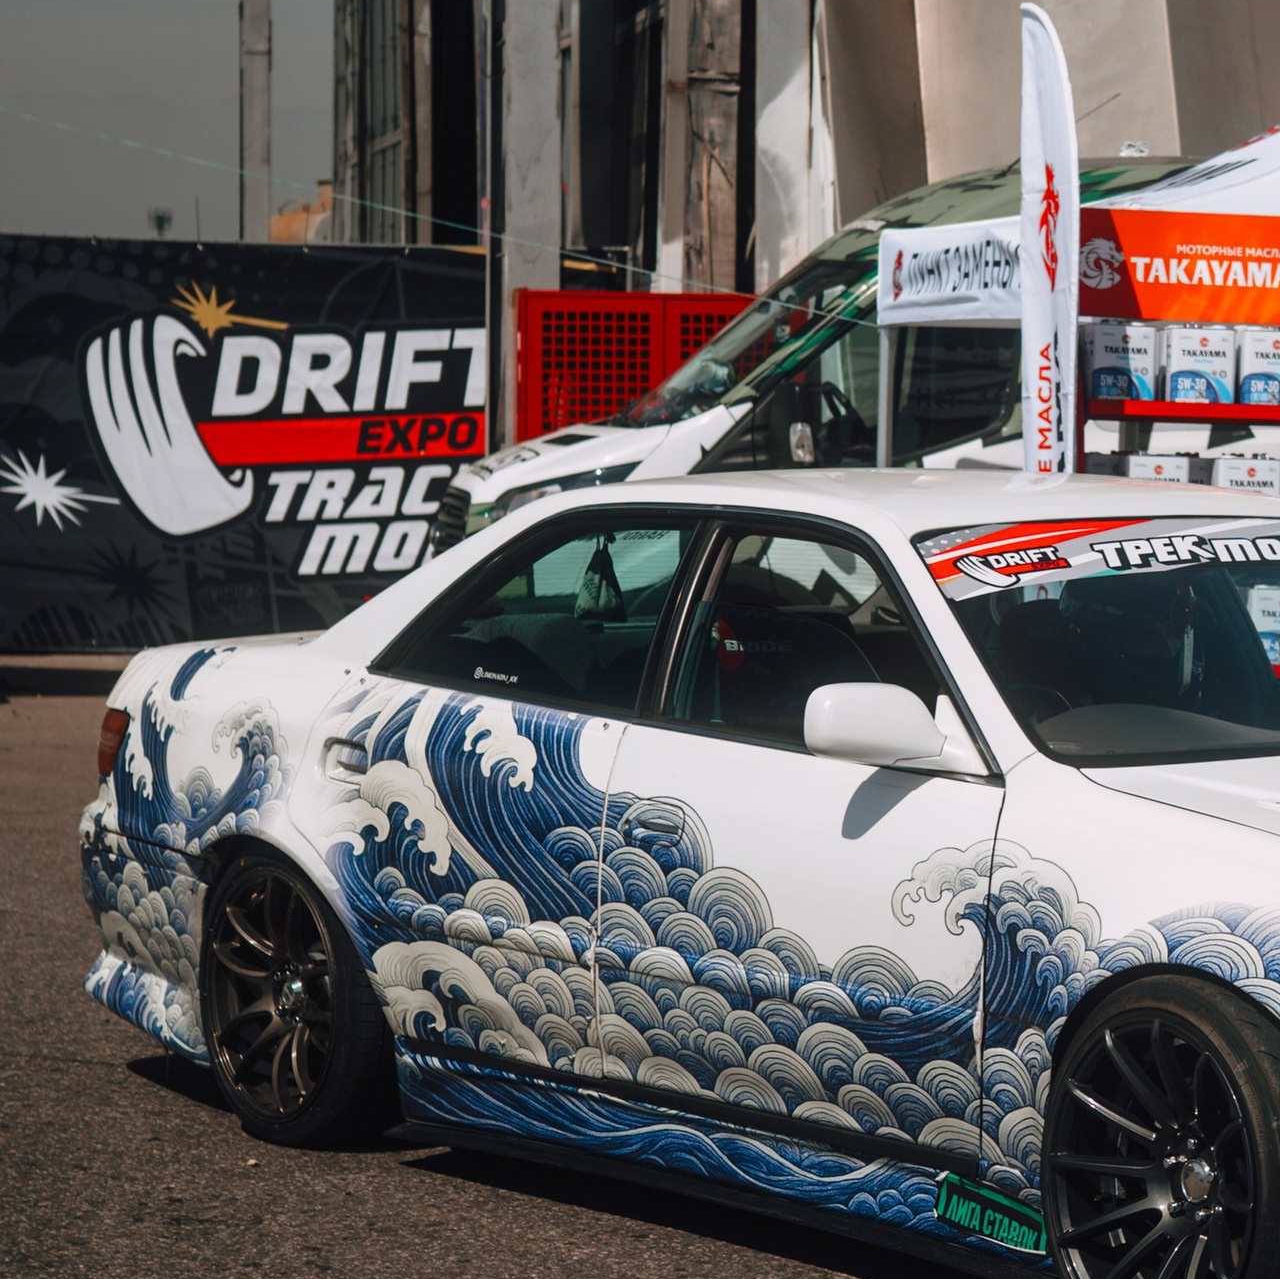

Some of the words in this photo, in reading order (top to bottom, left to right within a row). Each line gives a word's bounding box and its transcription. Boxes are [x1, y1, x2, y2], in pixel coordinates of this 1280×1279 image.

[1176, 243, 1243, 258] МОТОРНЫЕ
[1104, 345, 1149, 356] TAKAYAMA
[1181, 349, 1228, 359] TAKAYAMA
[211, 327, 487, 417] DRIFT
[1177, 376, 1207, 390] 5W-30
[1250, 379, 1280, 393] 5W-30
[356, 416, 479, 455] EXPO
[1229, 479, 1275, 489] TAKAYAMA
[265, 463, 470, 523] TRAC
[298, 520, 435, 576] MO
[987, 546, 1057, 569] DRIFT
[1032, 560, 1061, 571] EXPO
[945, 1193, 982, 1232] ЛИГА
[982, 1208, 1039, 1251] СТАВОК
